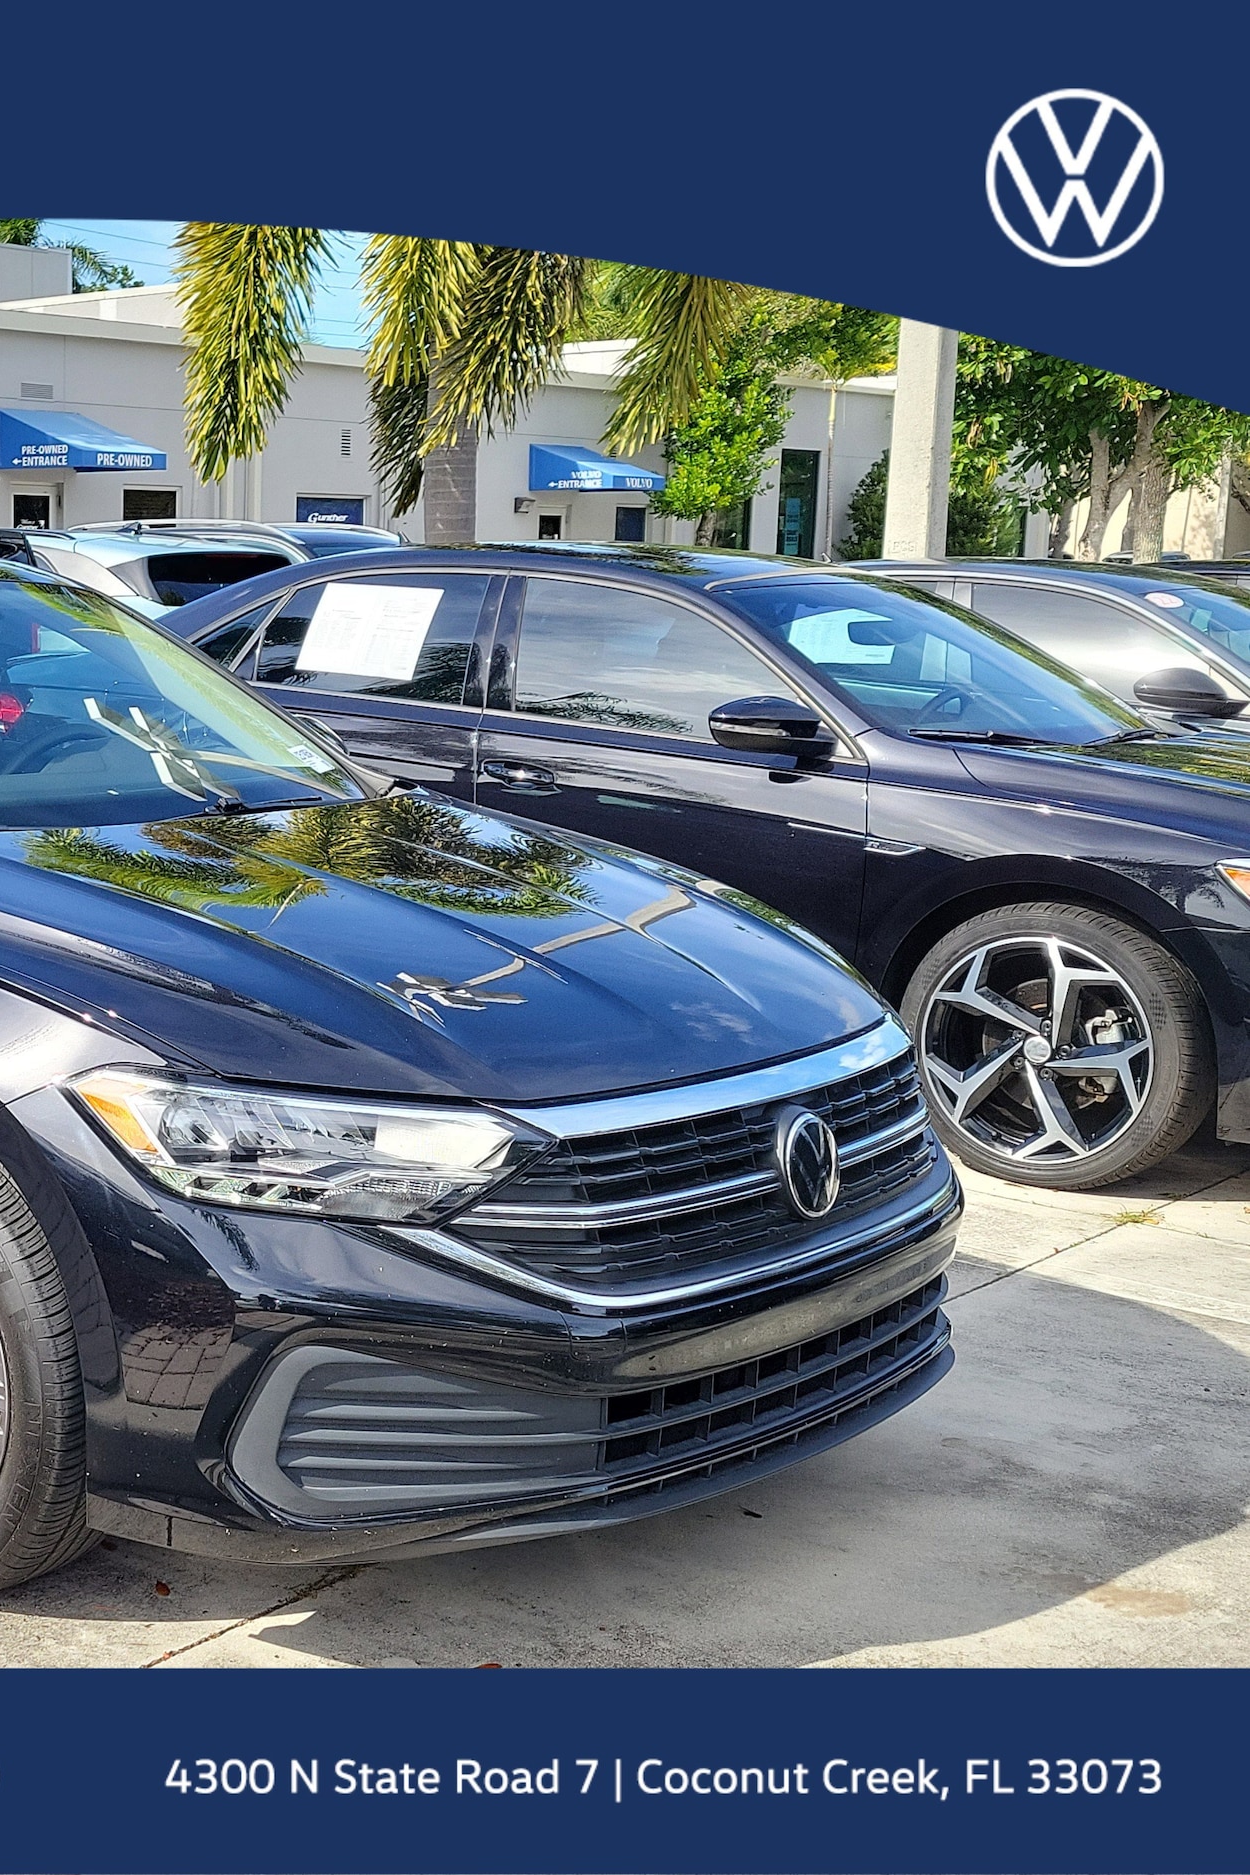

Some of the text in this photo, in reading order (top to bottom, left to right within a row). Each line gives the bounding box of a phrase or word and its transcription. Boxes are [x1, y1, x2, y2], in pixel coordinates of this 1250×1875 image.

[21, 445, 68, 455] PRE-OWNED
[22, 456, 67, 466] ENTRANCE
[97, 453, 152, 467] PRE-OWNED
[558, 480, 603, 488] ENTRANCE
[626, 478, 652, 488] VOLVO
